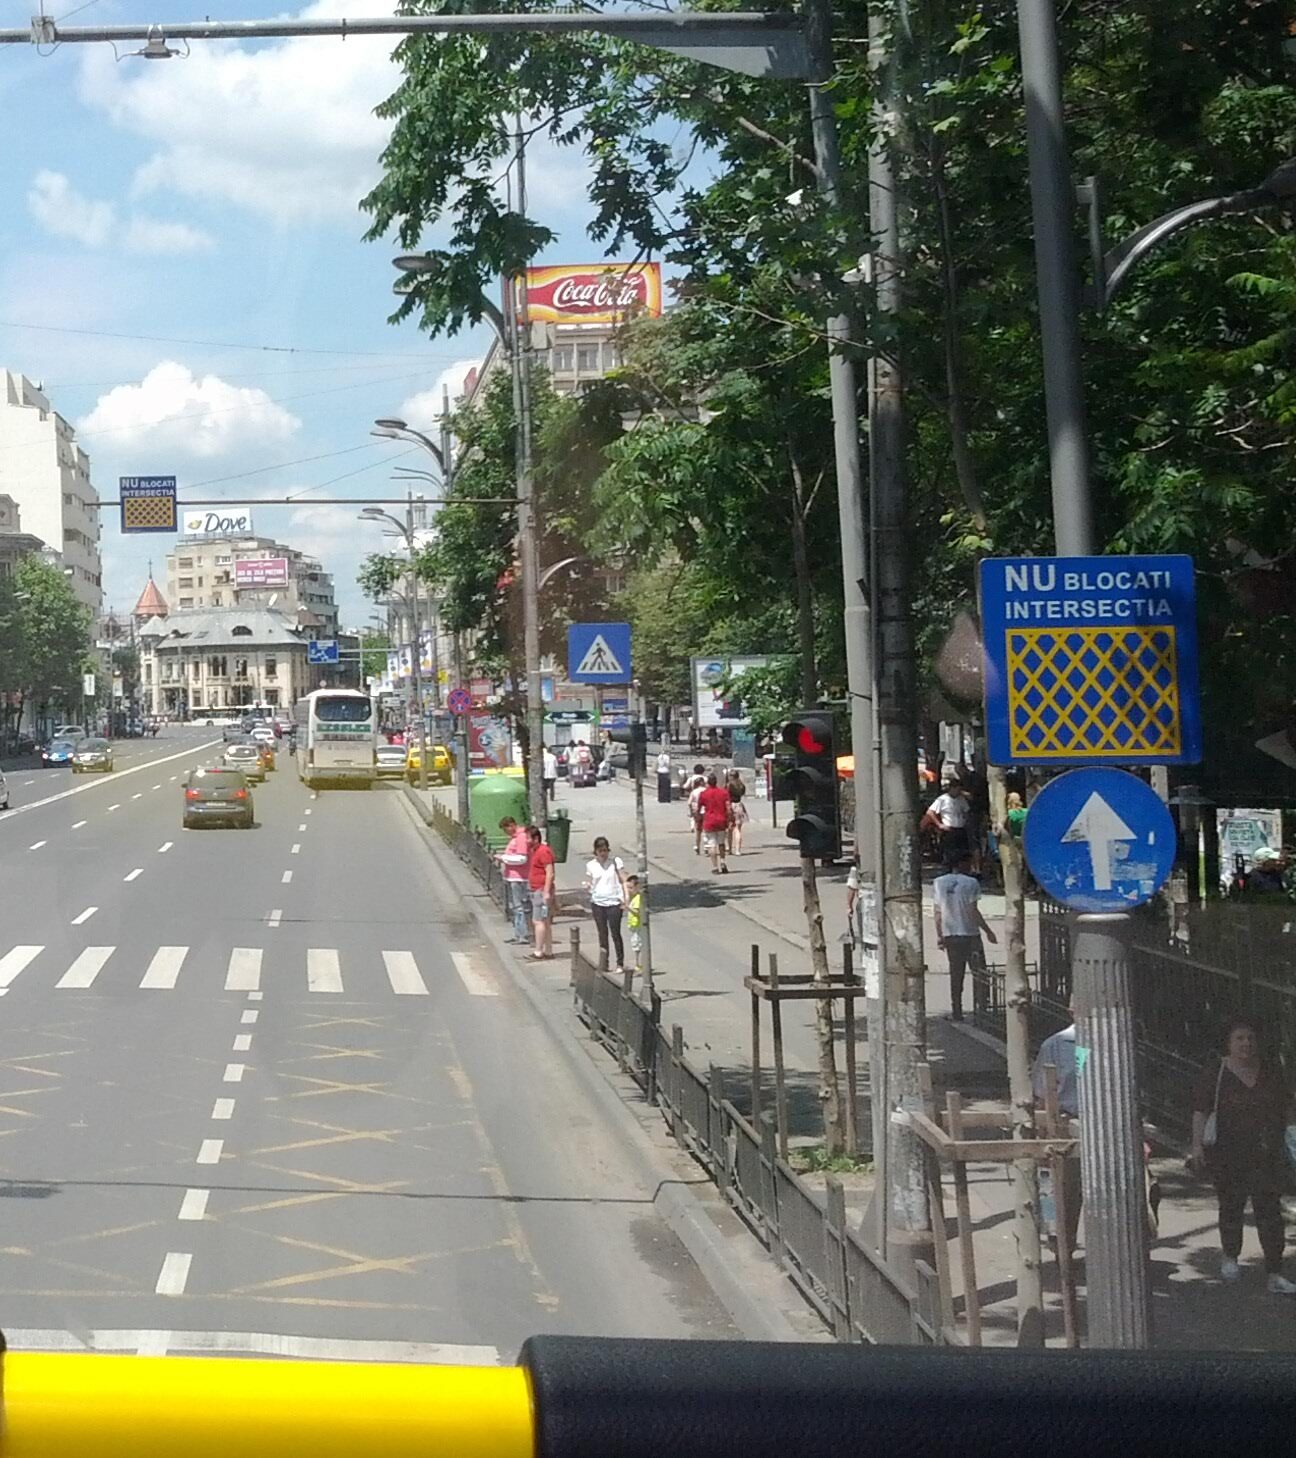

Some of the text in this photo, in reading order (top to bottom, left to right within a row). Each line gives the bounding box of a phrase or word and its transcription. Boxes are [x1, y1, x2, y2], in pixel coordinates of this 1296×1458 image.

[553, 277, 642, 308] Coca-Cla
[121, 479, 175, 488] NU BLOCATI
[121, 489, 175, 497] INTERSECTIA
[204, 512, 247, 533] Dove
[1005, 564, 1171, 592] NU BLOCATI
[1005, 598, 1173, 619] INTERSECTIA
